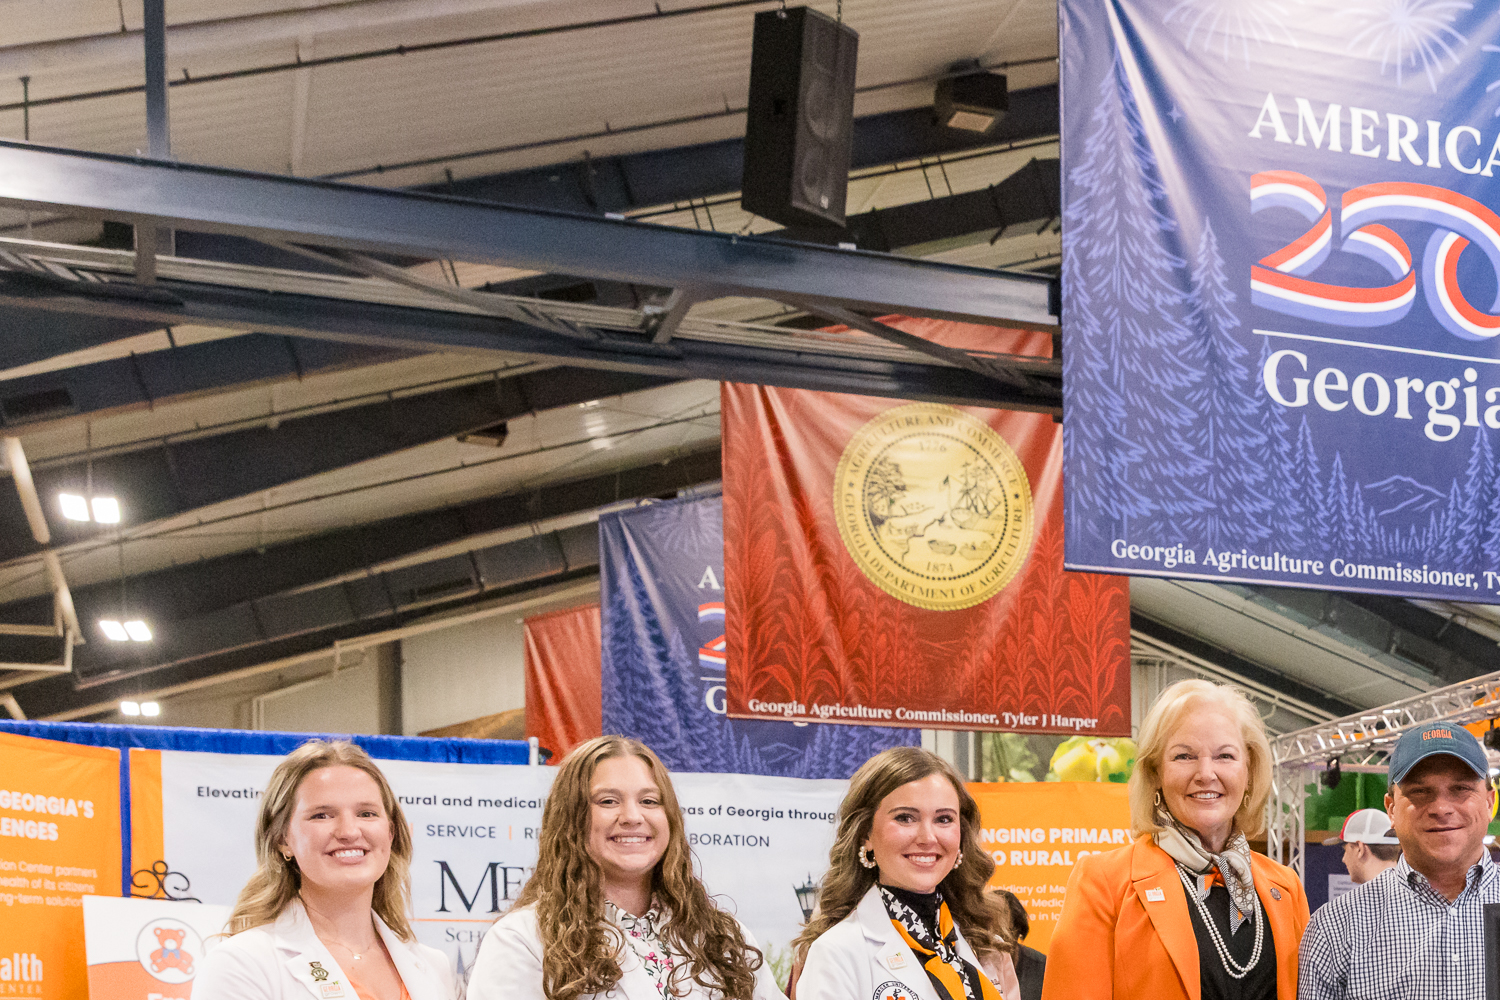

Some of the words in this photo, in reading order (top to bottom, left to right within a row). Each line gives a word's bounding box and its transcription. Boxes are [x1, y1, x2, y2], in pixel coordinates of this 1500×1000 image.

[850, 415, 921, 475] AGRICULTURE
[927, 415, 955, 427] AND
[958, 420, 1019, 486] COMMERCE
[919, 440, 947, 452] 1776
[844, 492, 870, 558] GEORGIA
[869, 556, 956, 600] DEPARTMENT
[960, 584, 976, 597] OF
[979, 507, 1023, 588] AGRICULTURE
[926, 561, 954, 573] 1874
[1111, 538, 1196, 569] Georgia
[1203, 547, 1324, 577] Agriculture
[1330, 558, 1479, 591] Commissioner,
[748, 698, 806, 717] Georgia
[810, 702, 892, 719] Agriculture
[895, 706, 1000, 726] Commissioner,
[1002, 711, 1039, 728] Tyler
[1041, 713, 1048, 728] J
[1050, 714, 1099, 731] Harper
[1422, 729, 1453, 741] GEORGIA
[442, 796, 473, 807] and
[478, 796, 545, 809] medical
[709, 805, 722, 816] of
[726, 806, 784, 821] Georgia
[788, 809, 837, 824] throug
[426, 824, 497, 839] SERVICE
[1010, 851, 1073, 866] RURAL
[1036, 884, 1046, 894] of
